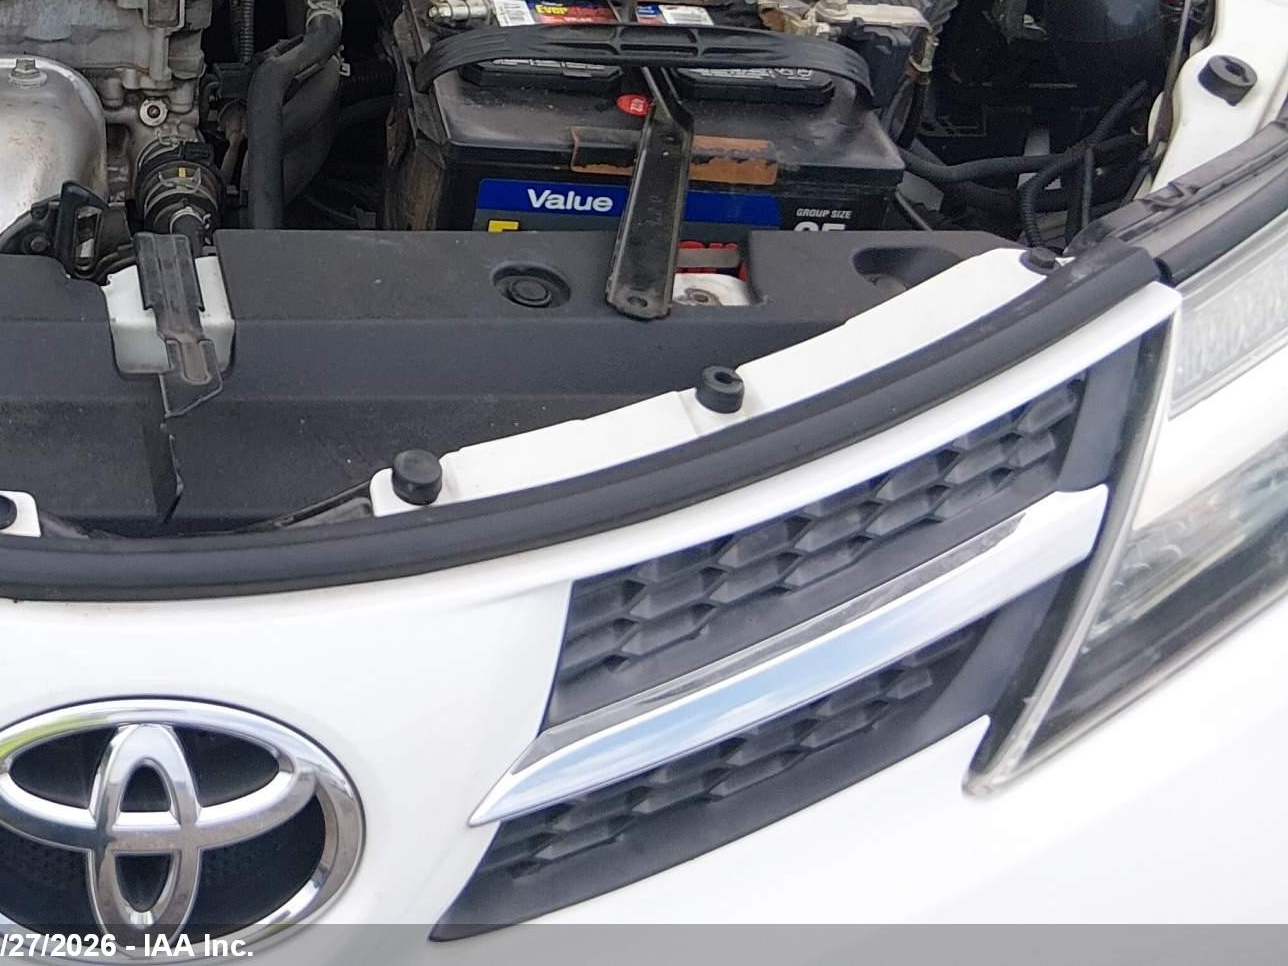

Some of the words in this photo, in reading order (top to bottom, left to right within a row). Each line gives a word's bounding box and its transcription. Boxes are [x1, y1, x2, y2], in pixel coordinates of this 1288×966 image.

[527, 188, 614, 212] Value
[795, 208, 831, 218] GROUP
[830, 209, 854, 220] SIZE
